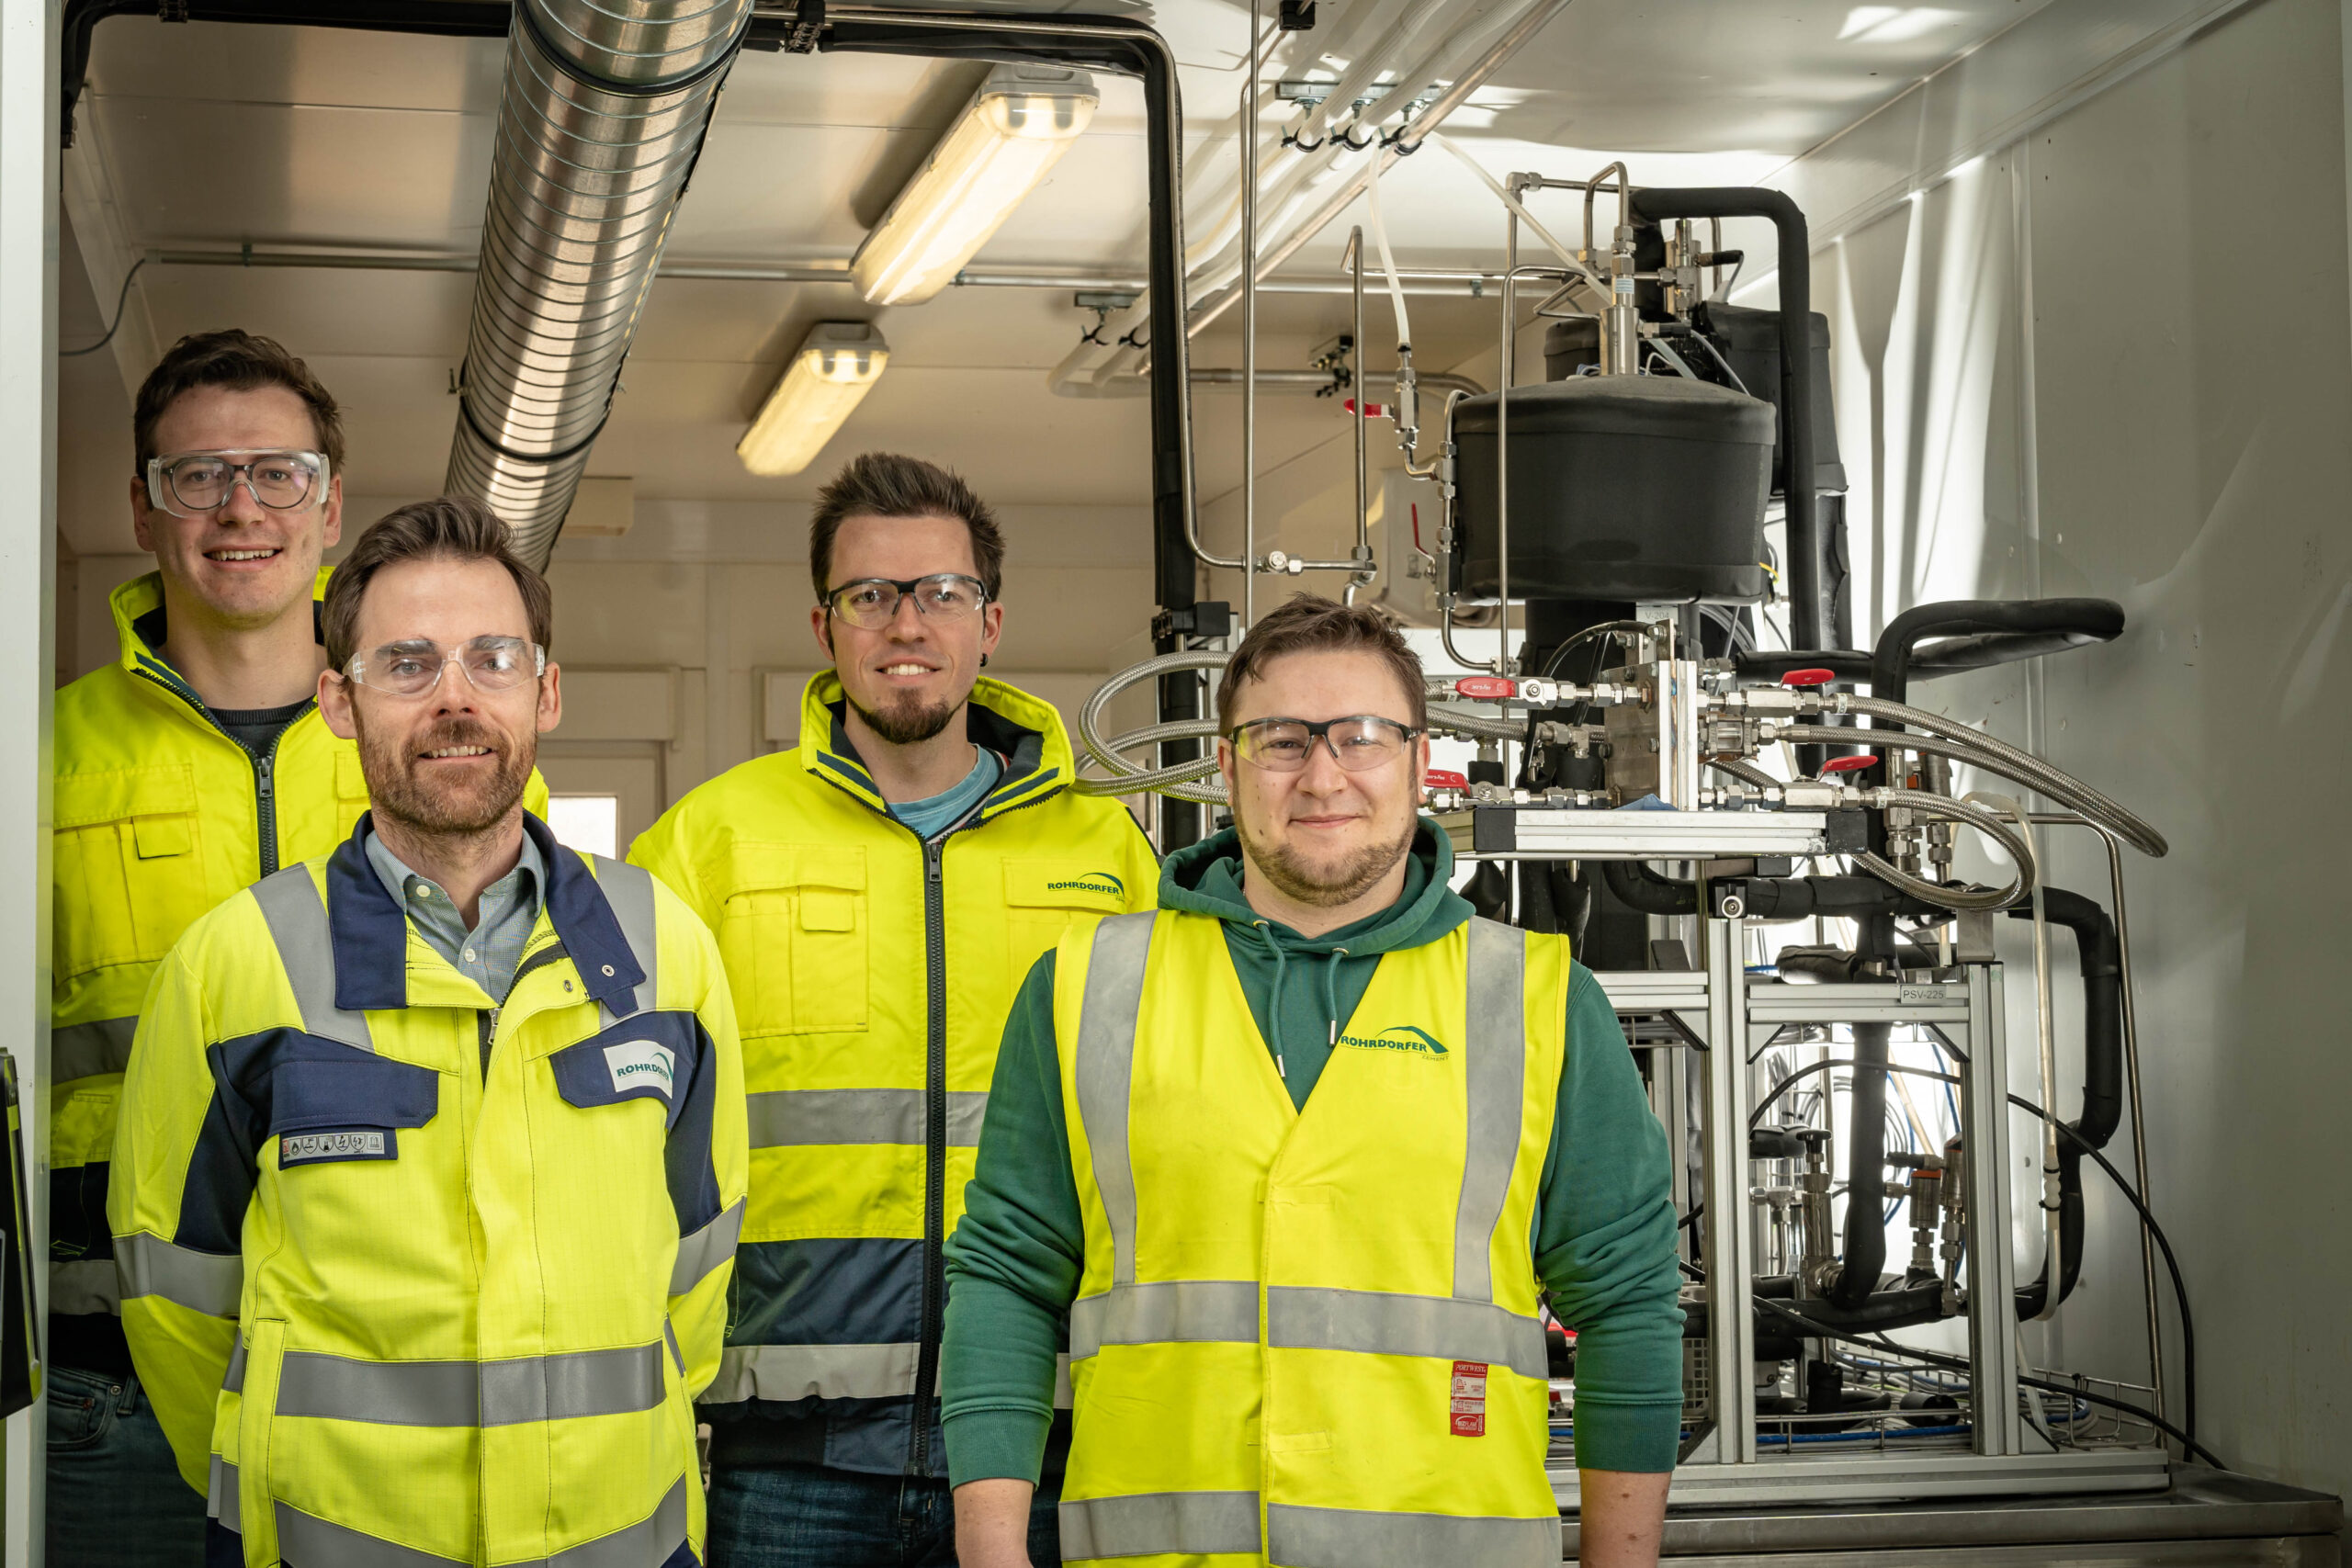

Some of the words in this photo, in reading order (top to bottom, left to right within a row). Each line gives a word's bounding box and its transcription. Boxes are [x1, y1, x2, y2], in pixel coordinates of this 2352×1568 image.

[1645, 610, 1669, 620] V-204
[1047, 881, 1120, 895] ROHRDORFER
[1903, 989, 1944, 999] PSV-225
[1340, 1035, 1428, 1053] ROHRDORFER
